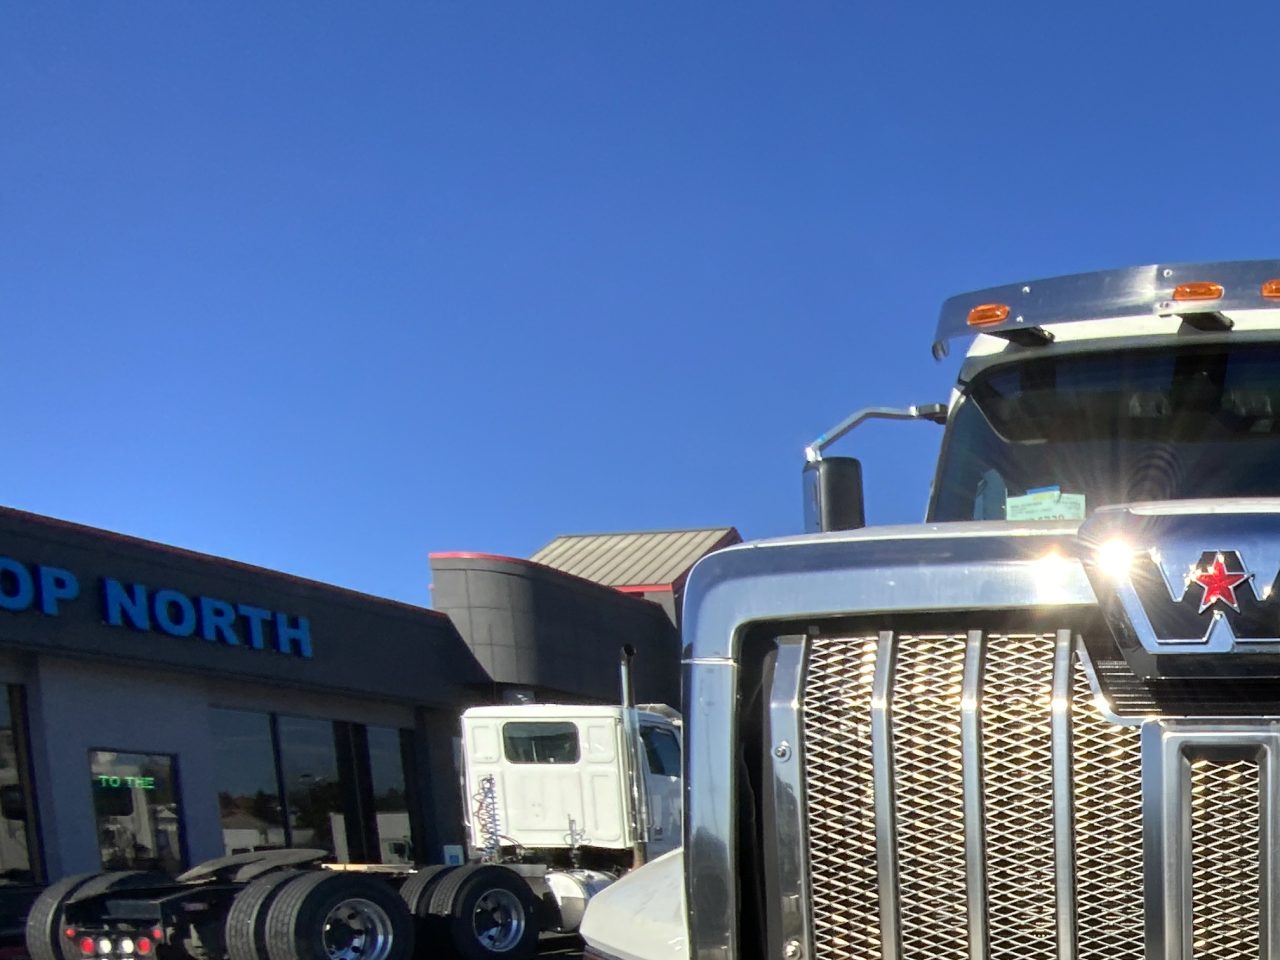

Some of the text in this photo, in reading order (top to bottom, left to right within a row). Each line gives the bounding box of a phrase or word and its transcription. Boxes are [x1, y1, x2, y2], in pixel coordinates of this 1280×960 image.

[99, 576, 314, 658] NORTH
[98, 775, 155, 789] TO THE
